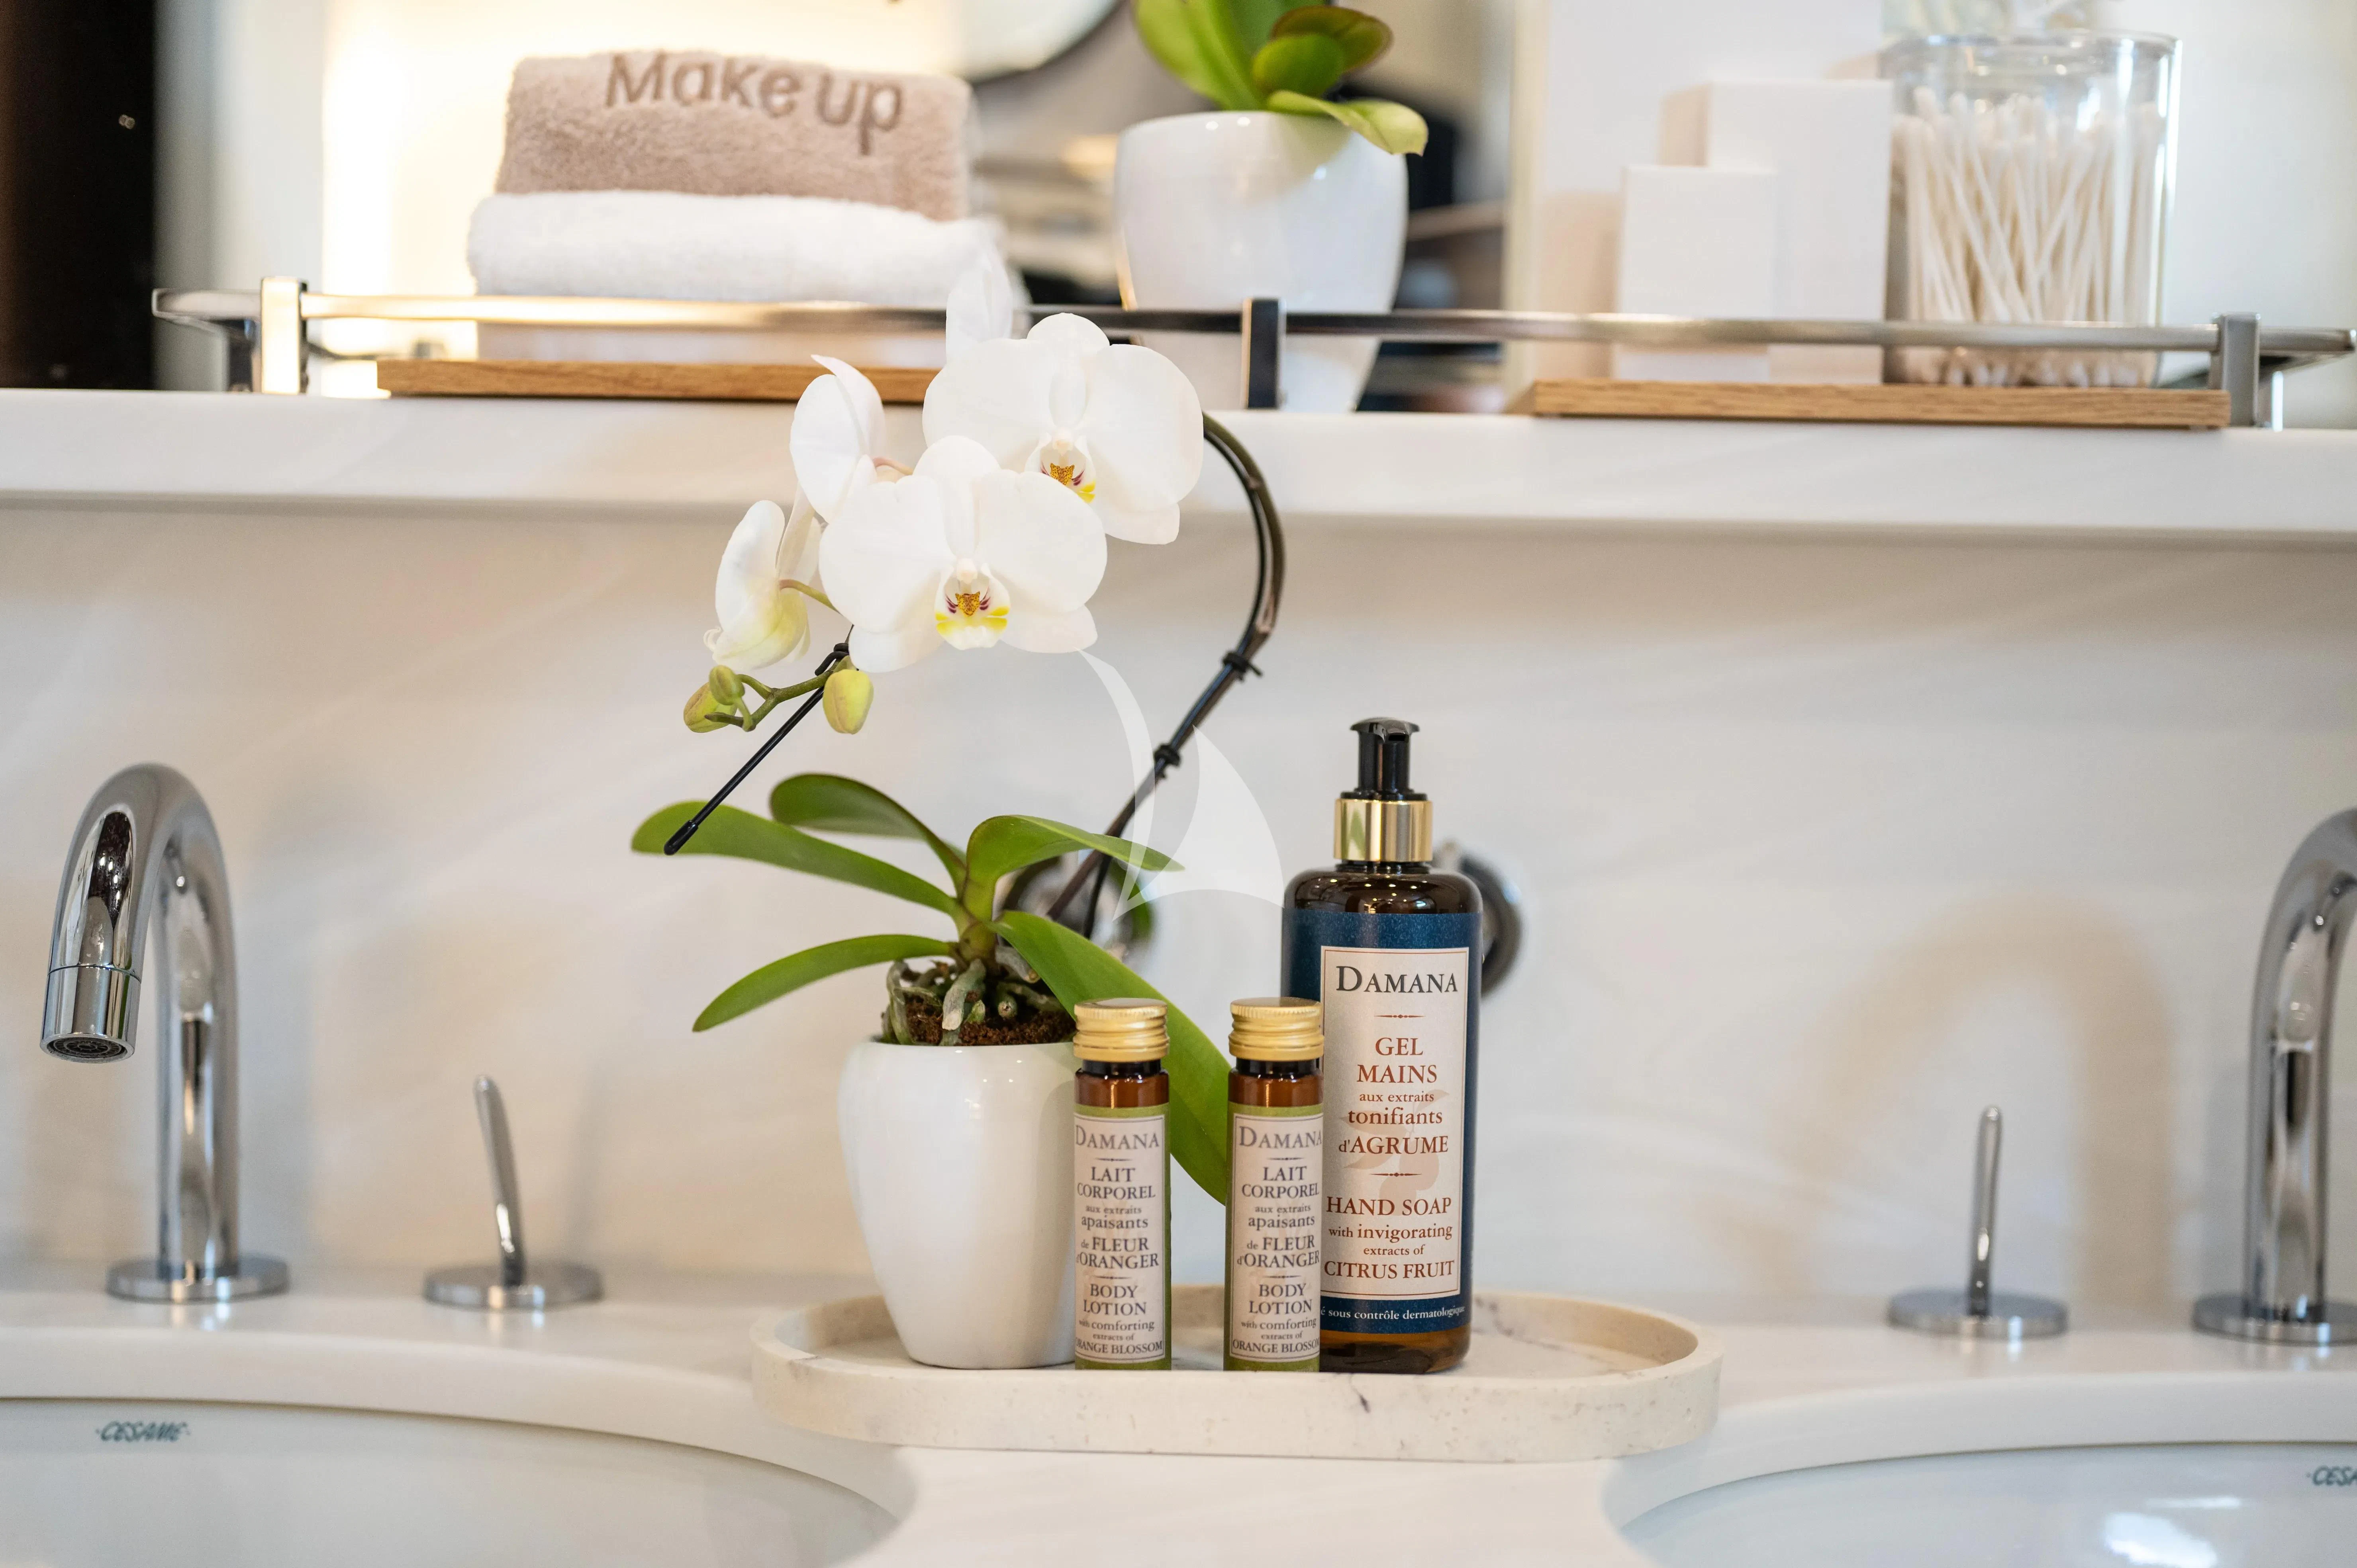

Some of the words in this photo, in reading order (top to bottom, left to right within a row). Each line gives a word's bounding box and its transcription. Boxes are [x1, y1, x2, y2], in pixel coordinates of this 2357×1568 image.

[604, 47, 801, 117] Make
[815, 71, 903, 155] up
[1375, 1037, 1424, 1056] GEL
[1356, 1064, 1437, 1084] MAINS
[1388, 1090, 1434, 1102] extraits
[1348, 1107, 1443, 1124] tonifiants
[1338, 1135, 1449, 1155] d'AGRUME
[1091, 1167, 1135, 1182] LAIT
[1263, 1166, 1307, 1181] LAIT
[1077, 1182, 1156, 1200] CORPOREL
[1242, 1182, 1320, 1199] CORPOREL
[1085, 1205, 1101, 1214] aux
[1103, 1205, 1142, 1214] extraits
[1277, 1203, 1311, 1213] extraits
[1326, 1196, 1395, 1216] HAND
[1402, 1197, 1452, 1216] SOAP
[1081, 1215, 1148, 1230] apaisants
[1248, 1215, 1315, 1231] apaisants
[1328, 1226, 1353, 1237] with
[1358, 1223, 1452, 1243] invigorating
[1081, 1239, 1089, 1249] de
[1092, 1236, 1149, 1252] FLEUR
[1247, 1239, 1258, 1250] de
[1263, 1235, 1315, 1251] FLEUR
[1364, 1247, 1410, 1255] extracts
[1413, 1244, 1425, 1255] of
[1237, 1250, 1320, 1268] d'ORANGER
[1324, 1261, 1397, 1279] CITRUS
[1403, 1261, 1455, 1279] FRUIT
[1090, 1284, 1138, 1299] BODY
[1259, 1283, 1306, 1297] BODY
[1083, 1299, 1147, 1315] LOTION
[1249, 1299, 1313, 1315] LOTION
[1328, 1309, 1351, 1318] sous
[1354, 1310, 1399, 1320] contrôle
[1091, 1319, 1155, 1331] comforting
[1241, 1320, 1257, 1329] with
[1260, 1317, 1317, 1330] comforting
[1111, 1340, 1163, 1354] BLOSSOM
[1233, 1339, 1278, 1353] ORANGE
